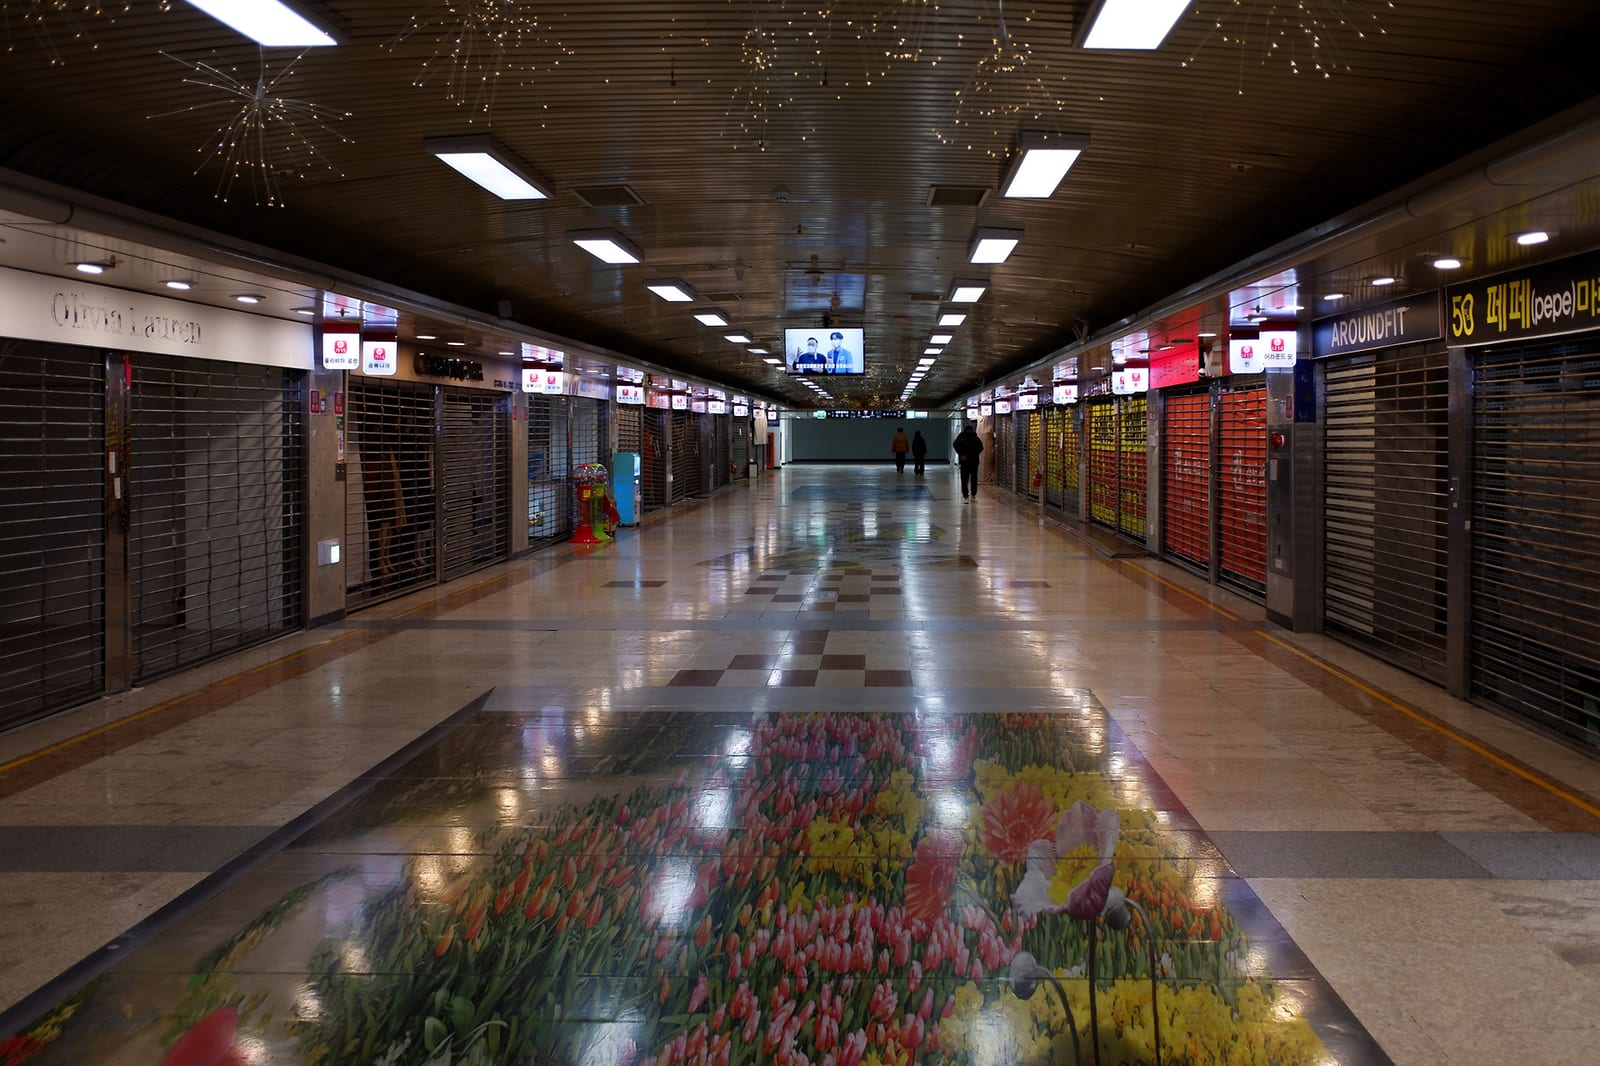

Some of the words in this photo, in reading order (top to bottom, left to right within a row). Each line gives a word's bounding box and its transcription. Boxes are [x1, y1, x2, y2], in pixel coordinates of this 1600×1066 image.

[52, 291, 122, 334] Olivia
[129, 306, 202, 344] Lauren
[1331, 306, 1408, 348] AROUNDFIT
